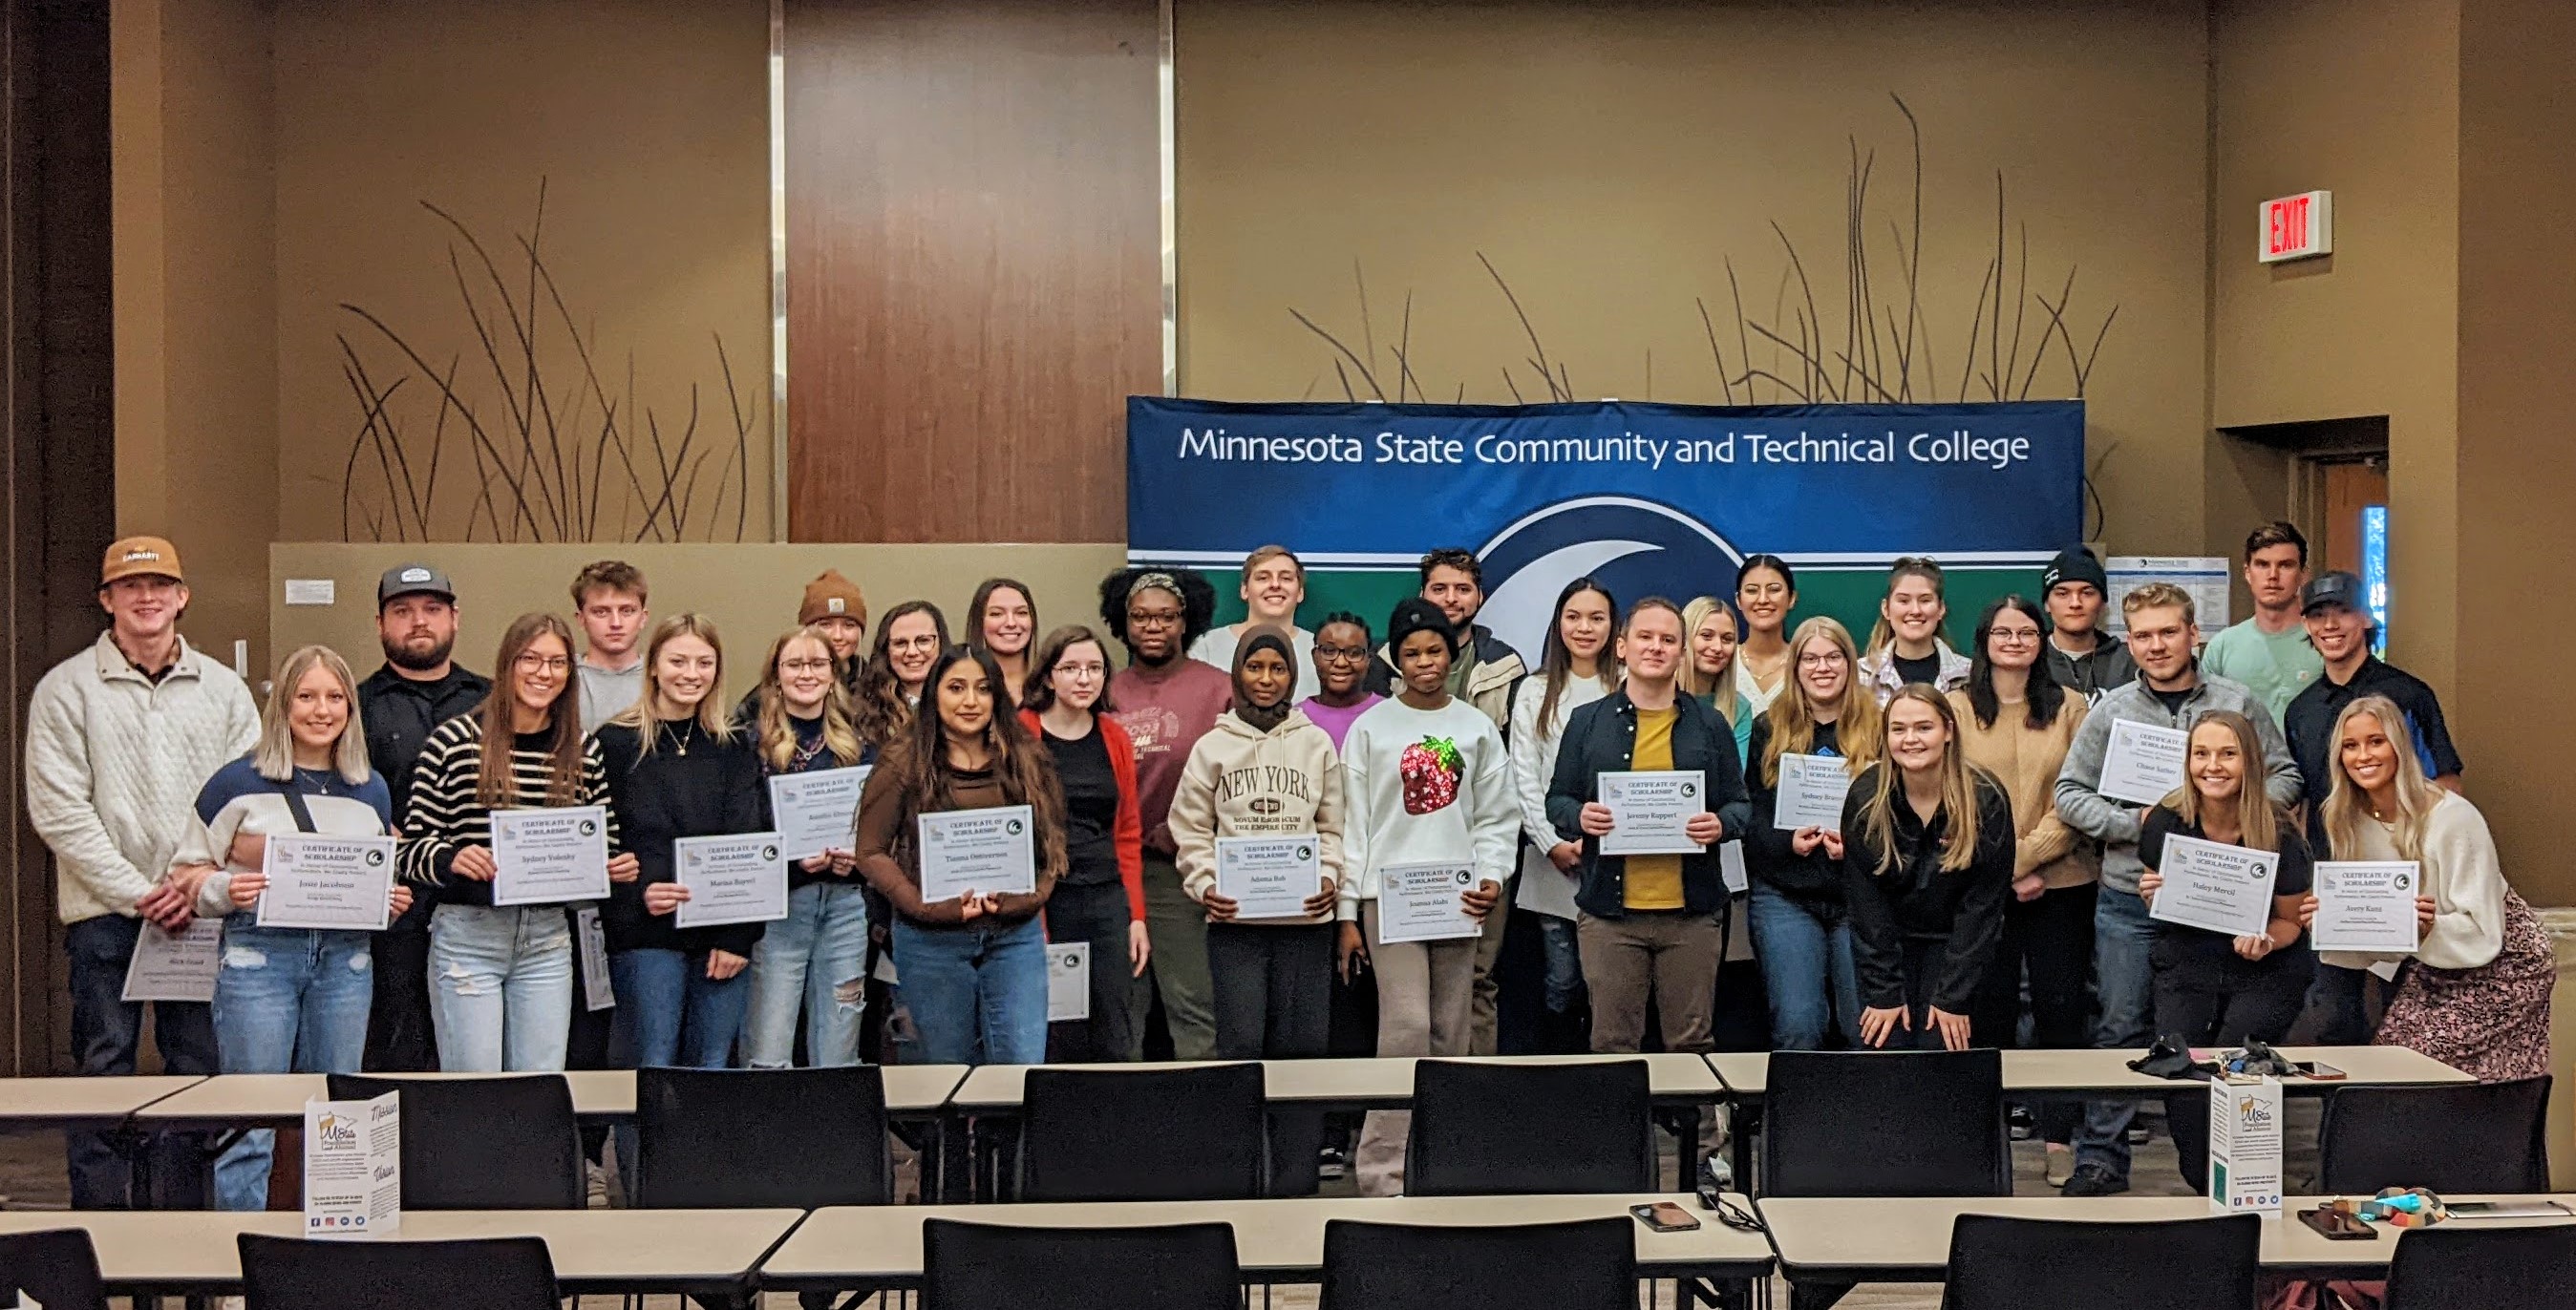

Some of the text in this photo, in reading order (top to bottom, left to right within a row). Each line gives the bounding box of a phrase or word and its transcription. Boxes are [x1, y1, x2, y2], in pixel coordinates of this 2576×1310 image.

[2270, 198, 2309, 254] EXIT
[1179, 428, 2030, 470] Minnesota State Community and Technical College
[1221, 766, 1310, 803] NEW YORK
[2195, 850, 2238, 862] CERTIFICATE
[2197, 858, 2243, 871] SCHOLARSHIP
